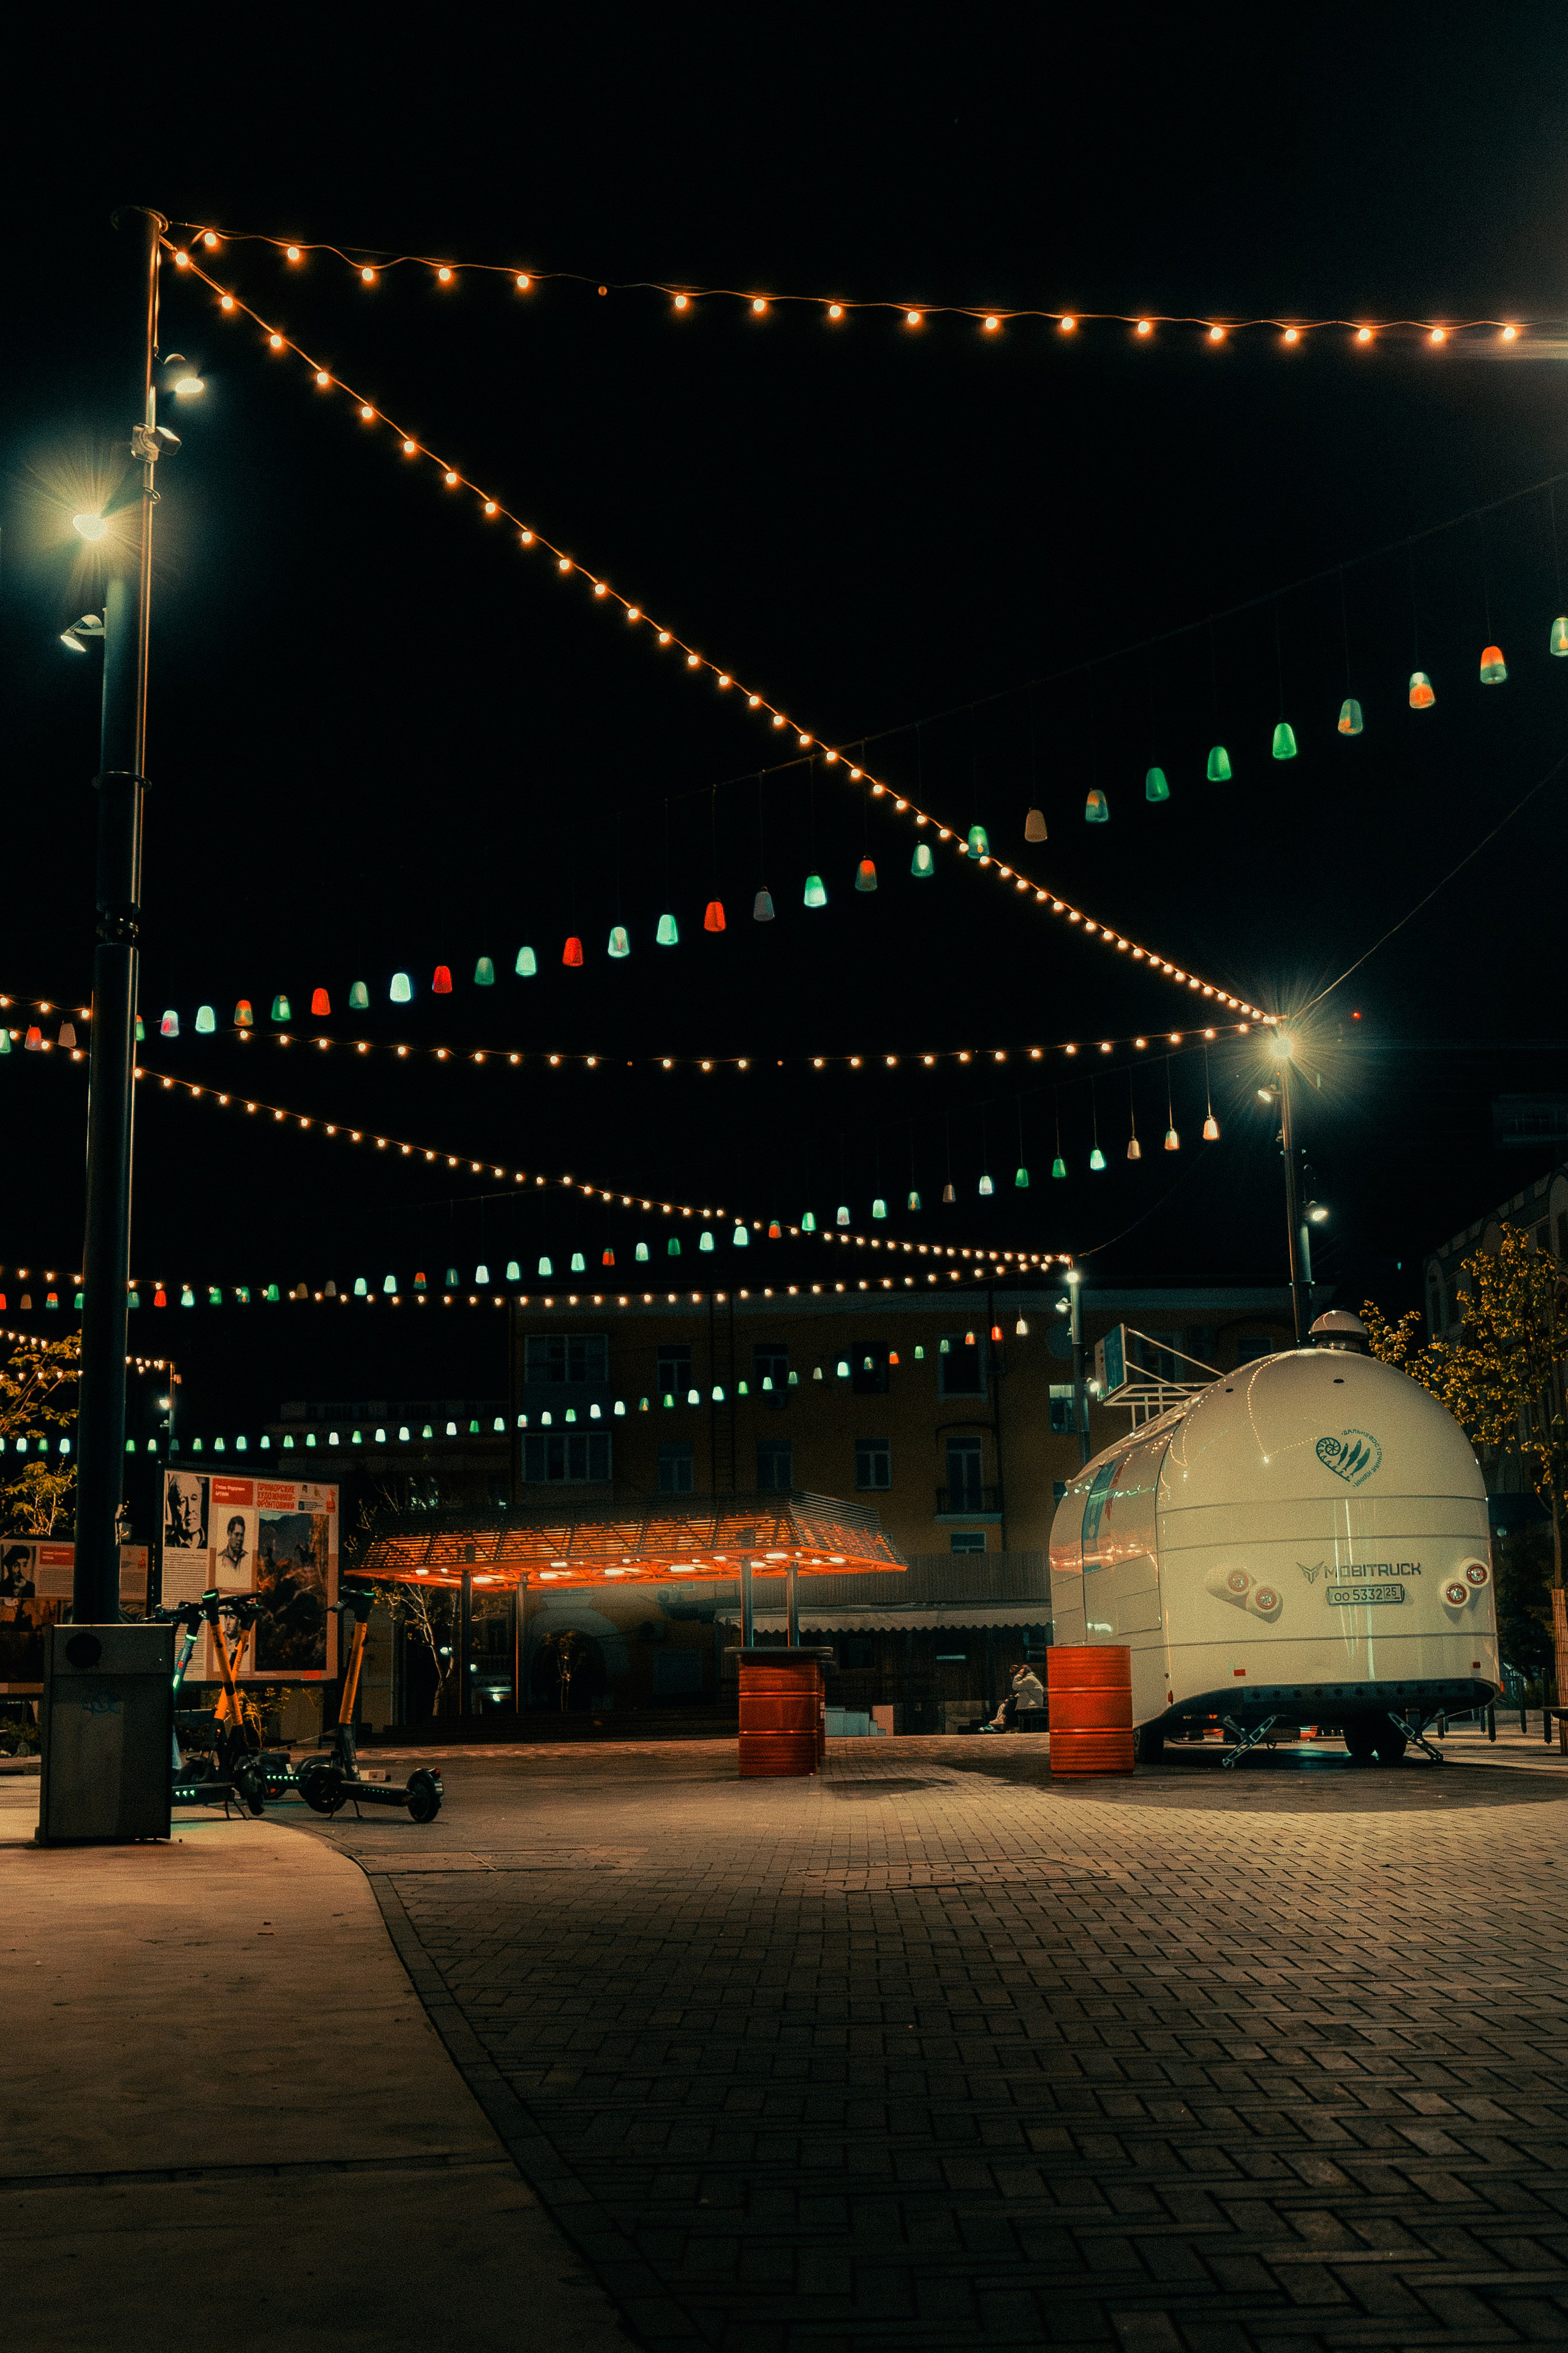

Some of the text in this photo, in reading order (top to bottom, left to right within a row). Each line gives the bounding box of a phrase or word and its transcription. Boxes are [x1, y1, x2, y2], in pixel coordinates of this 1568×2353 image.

[1324, 1563, 1421, 1578] MOBITRUCK
[1352, 1588, 1382, 1601] 5332
[1385, 1587, 1397, 1596] 25
